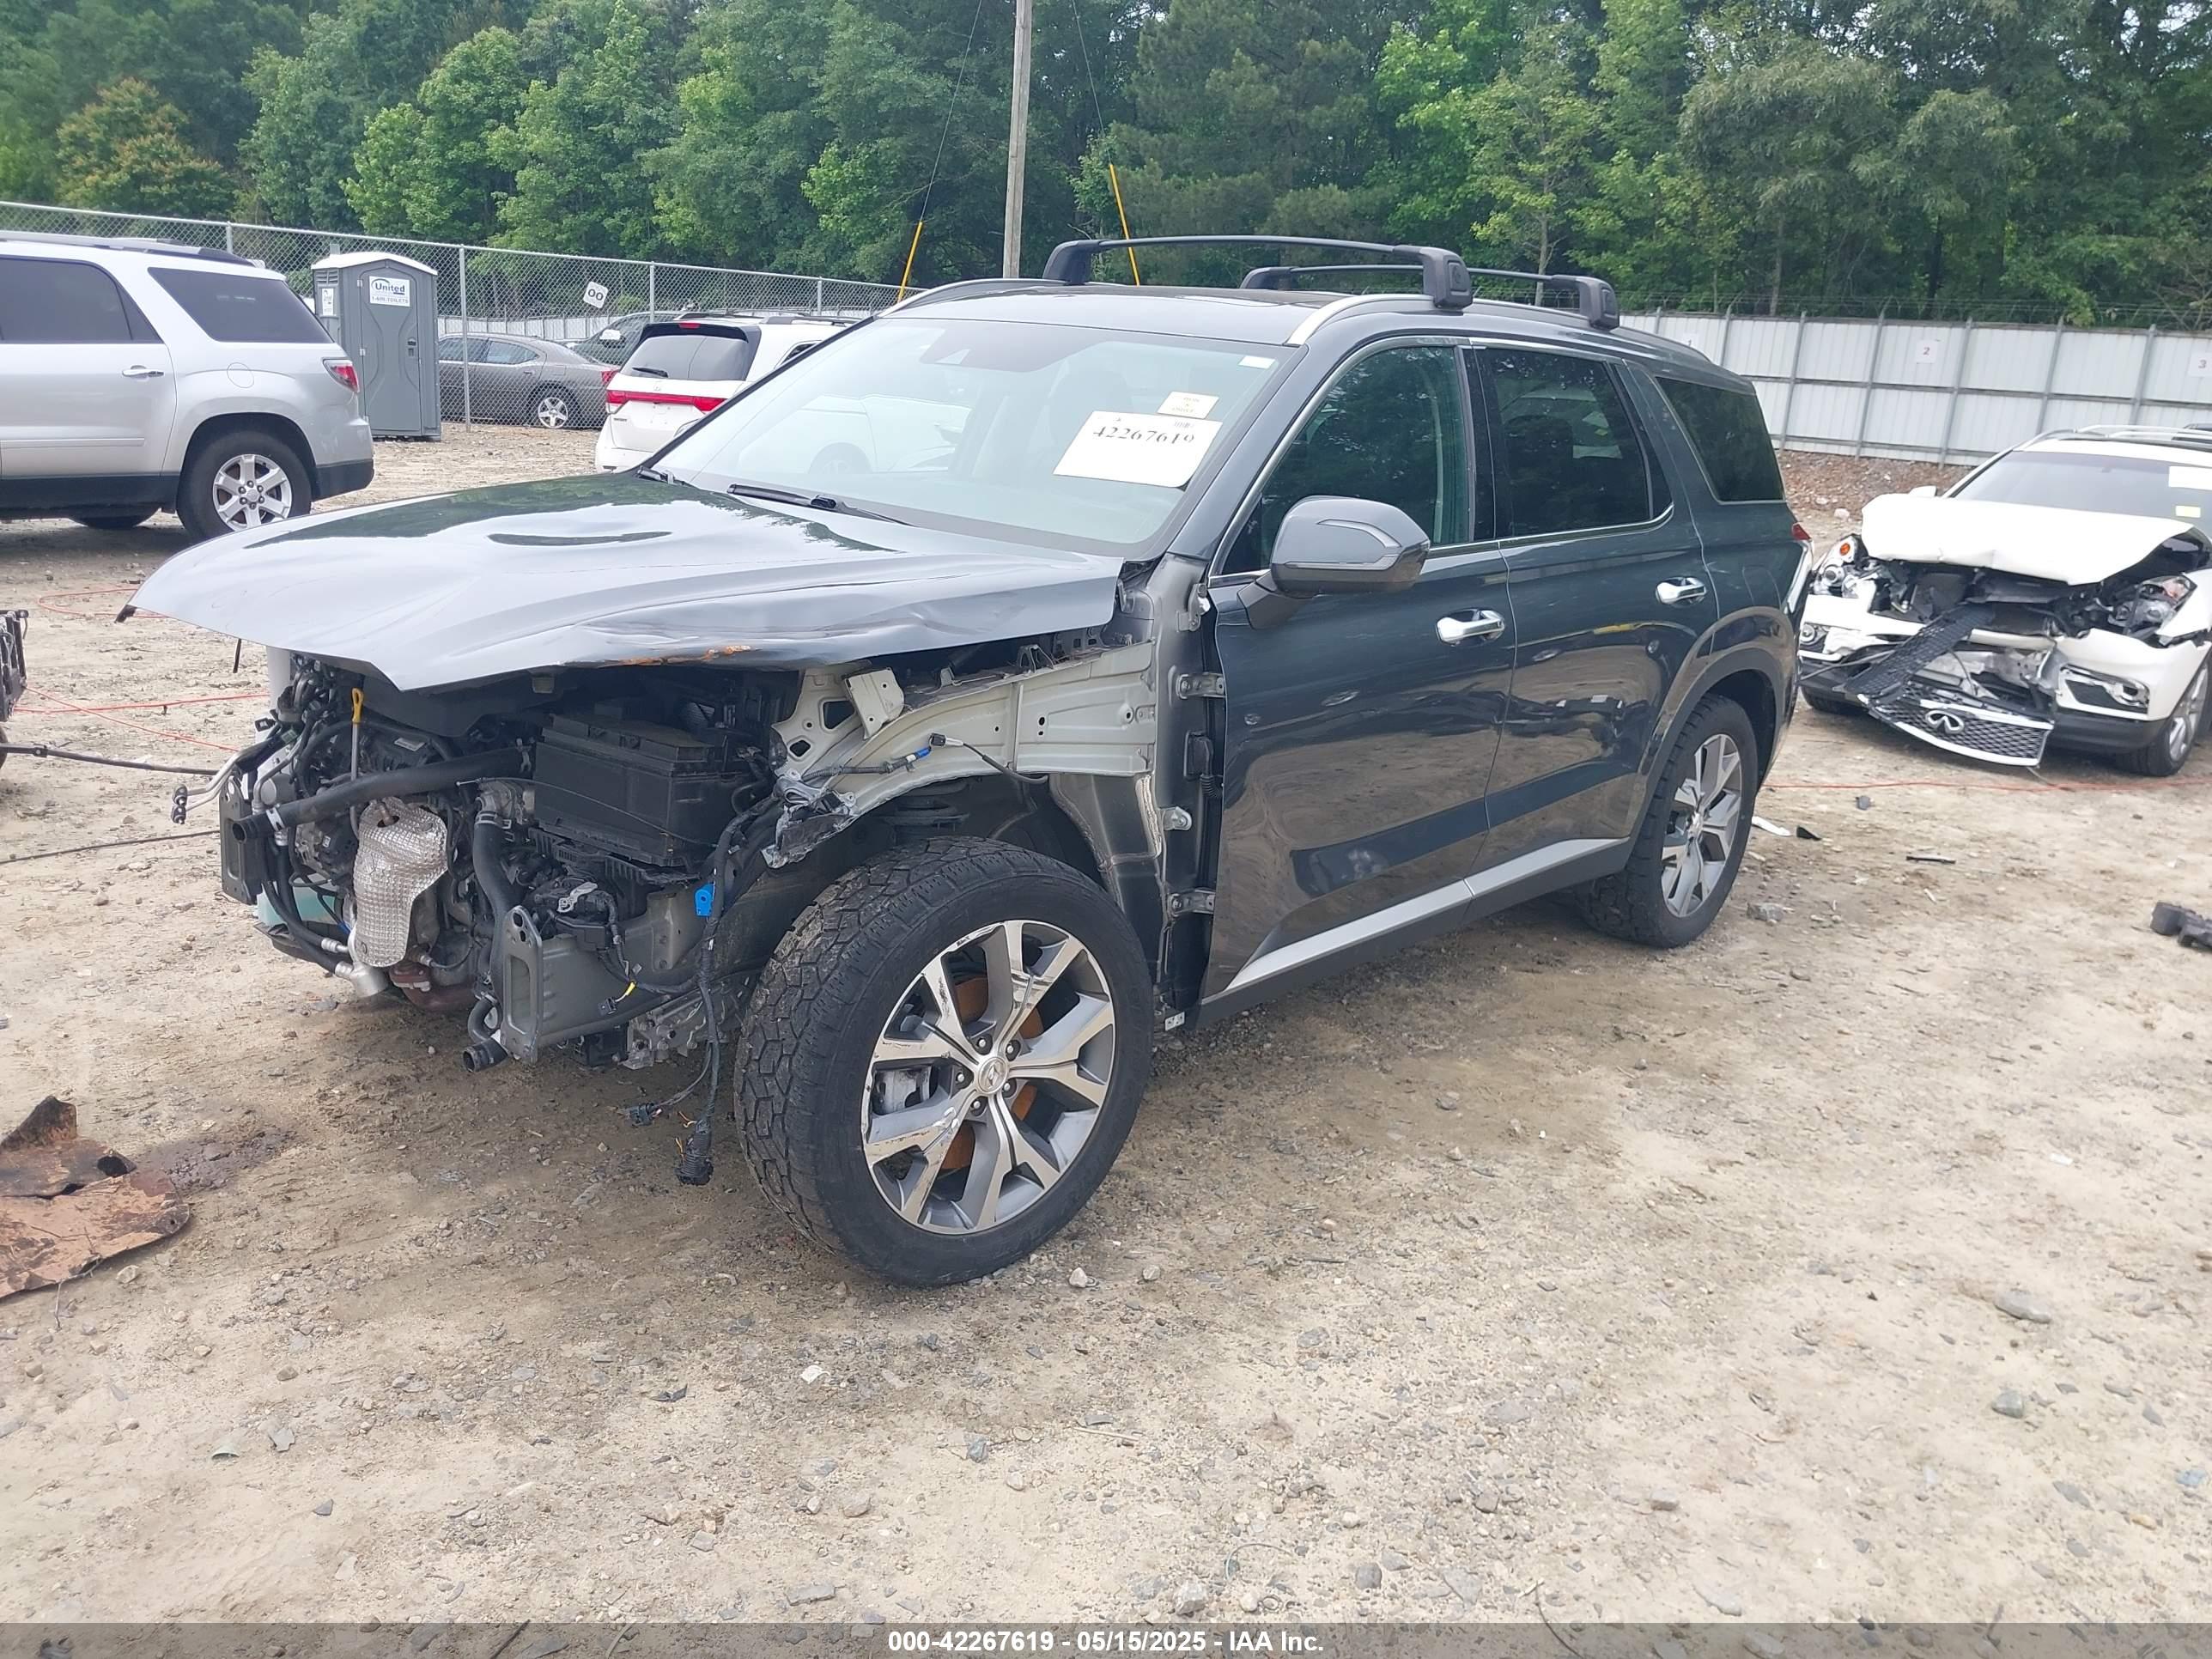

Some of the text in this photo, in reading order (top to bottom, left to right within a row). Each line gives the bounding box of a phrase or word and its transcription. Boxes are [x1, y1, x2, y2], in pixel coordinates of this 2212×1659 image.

[375, 283, 405, 292] United
[1923, 346, 1930, 356] 2
[2198, 359, 2207, 369] 3
[1093, 426, 1194, 444] 42267619
